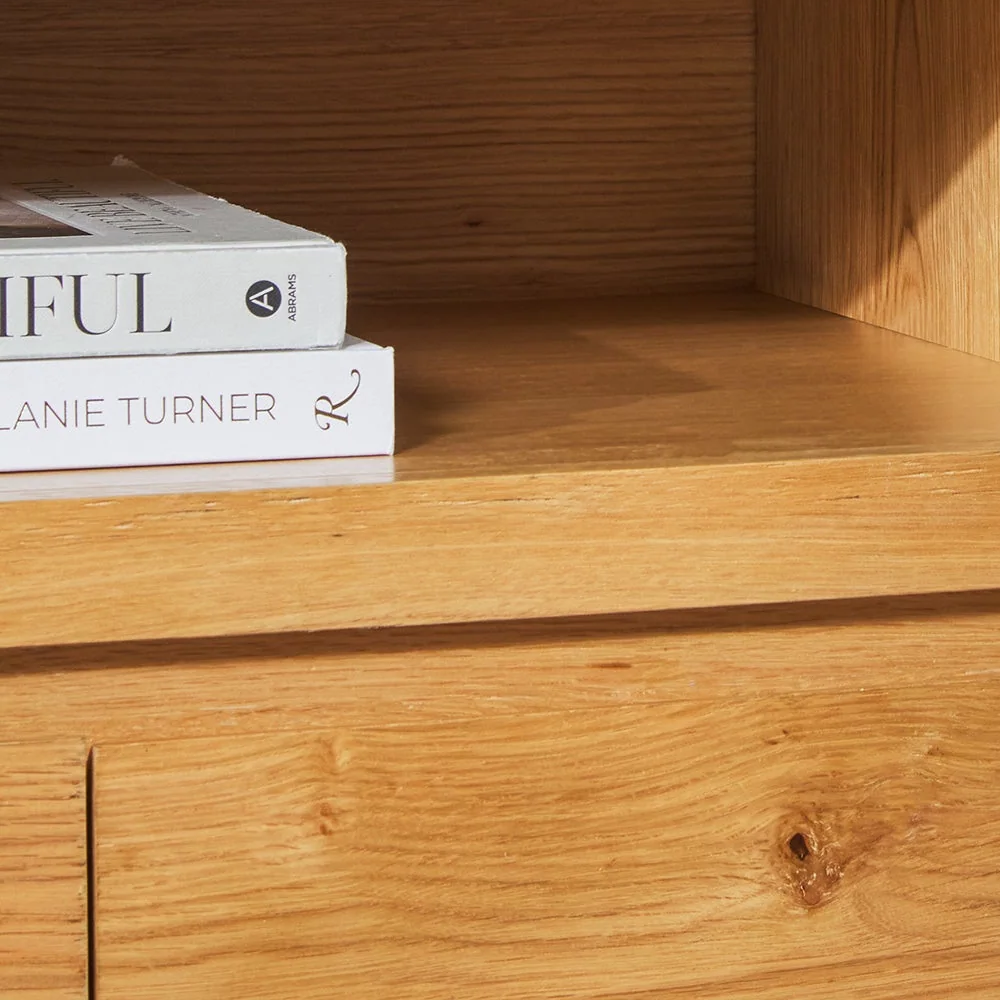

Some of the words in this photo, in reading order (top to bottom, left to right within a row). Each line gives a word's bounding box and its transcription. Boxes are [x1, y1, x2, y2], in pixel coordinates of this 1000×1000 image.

[0, 272, 173, 338] IFUL
[287, 273, 297, 322] ABRAMS
[117, 392, 277, 427] TURNER
[314, 368, 361, 431] R
